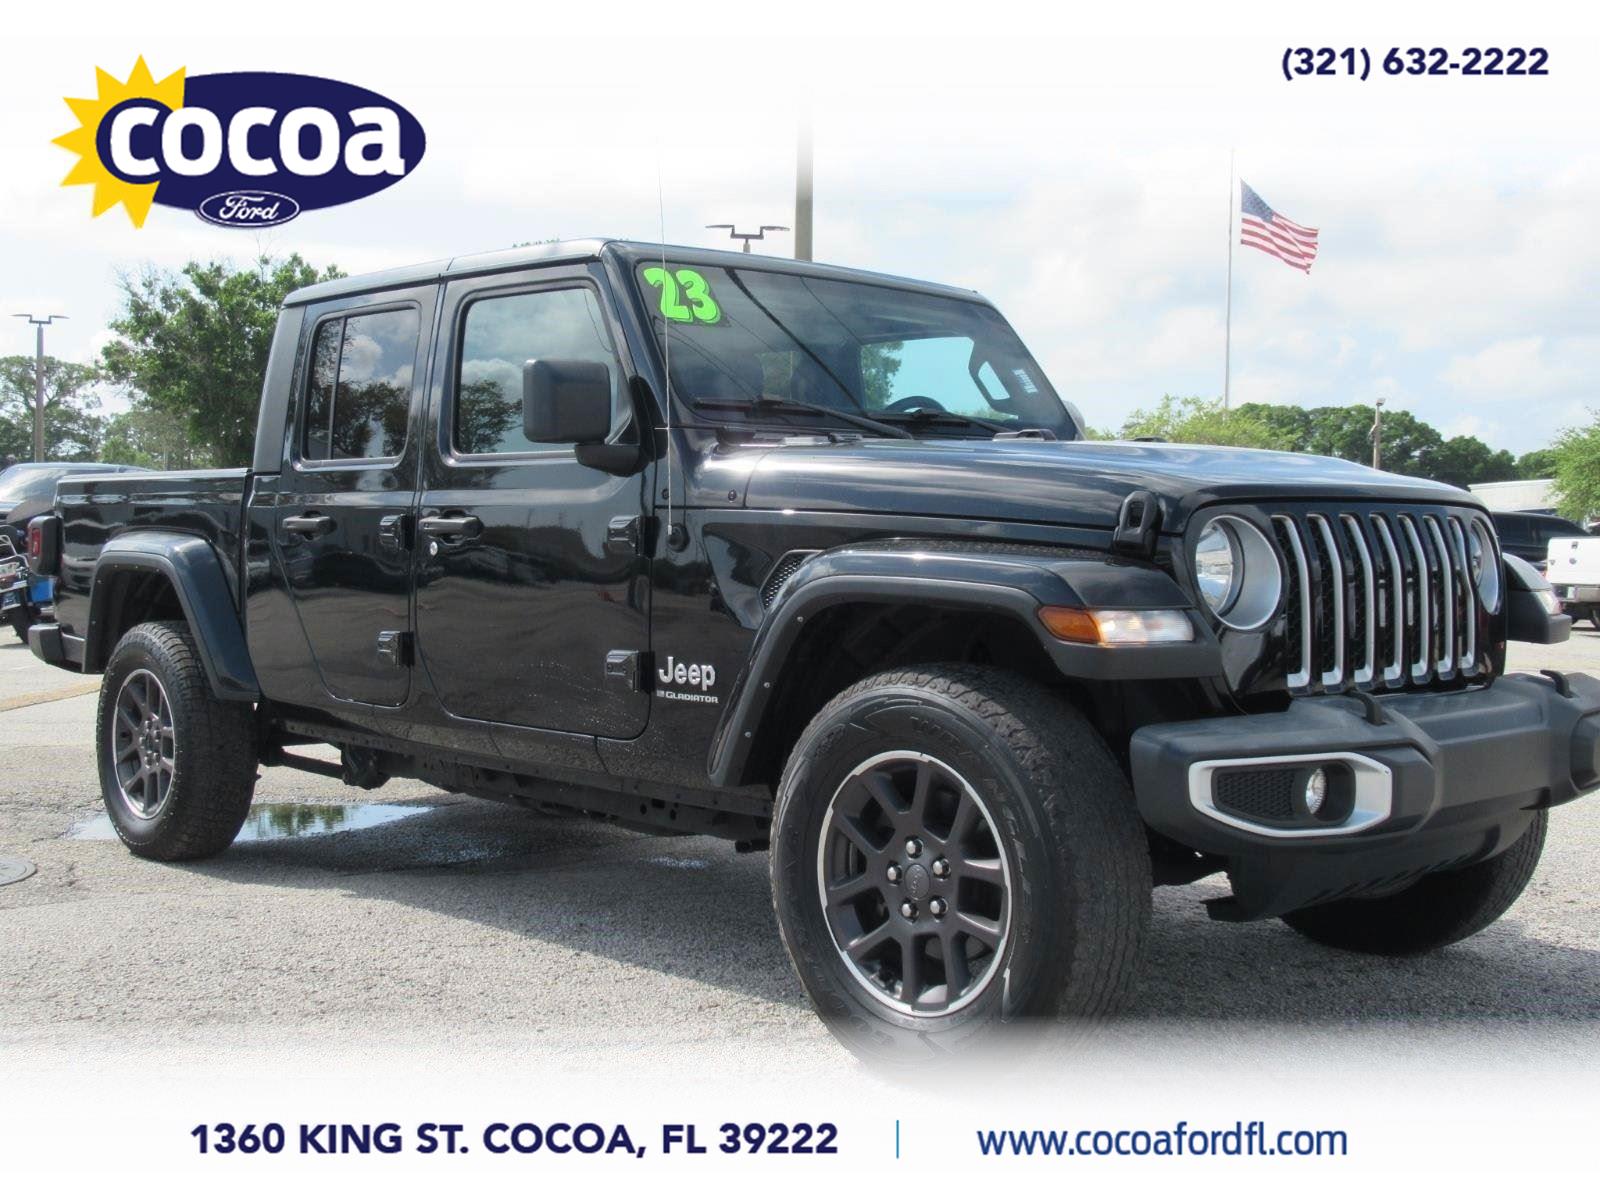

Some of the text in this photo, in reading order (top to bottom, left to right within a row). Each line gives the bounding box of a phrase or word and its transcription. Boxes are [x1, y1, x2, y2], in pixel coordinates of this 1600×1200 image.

[643, 267, 721, 324] 23
[658, 656, 716, 692] Jeep
[665, 691, 719, 704] GLADIATOR
